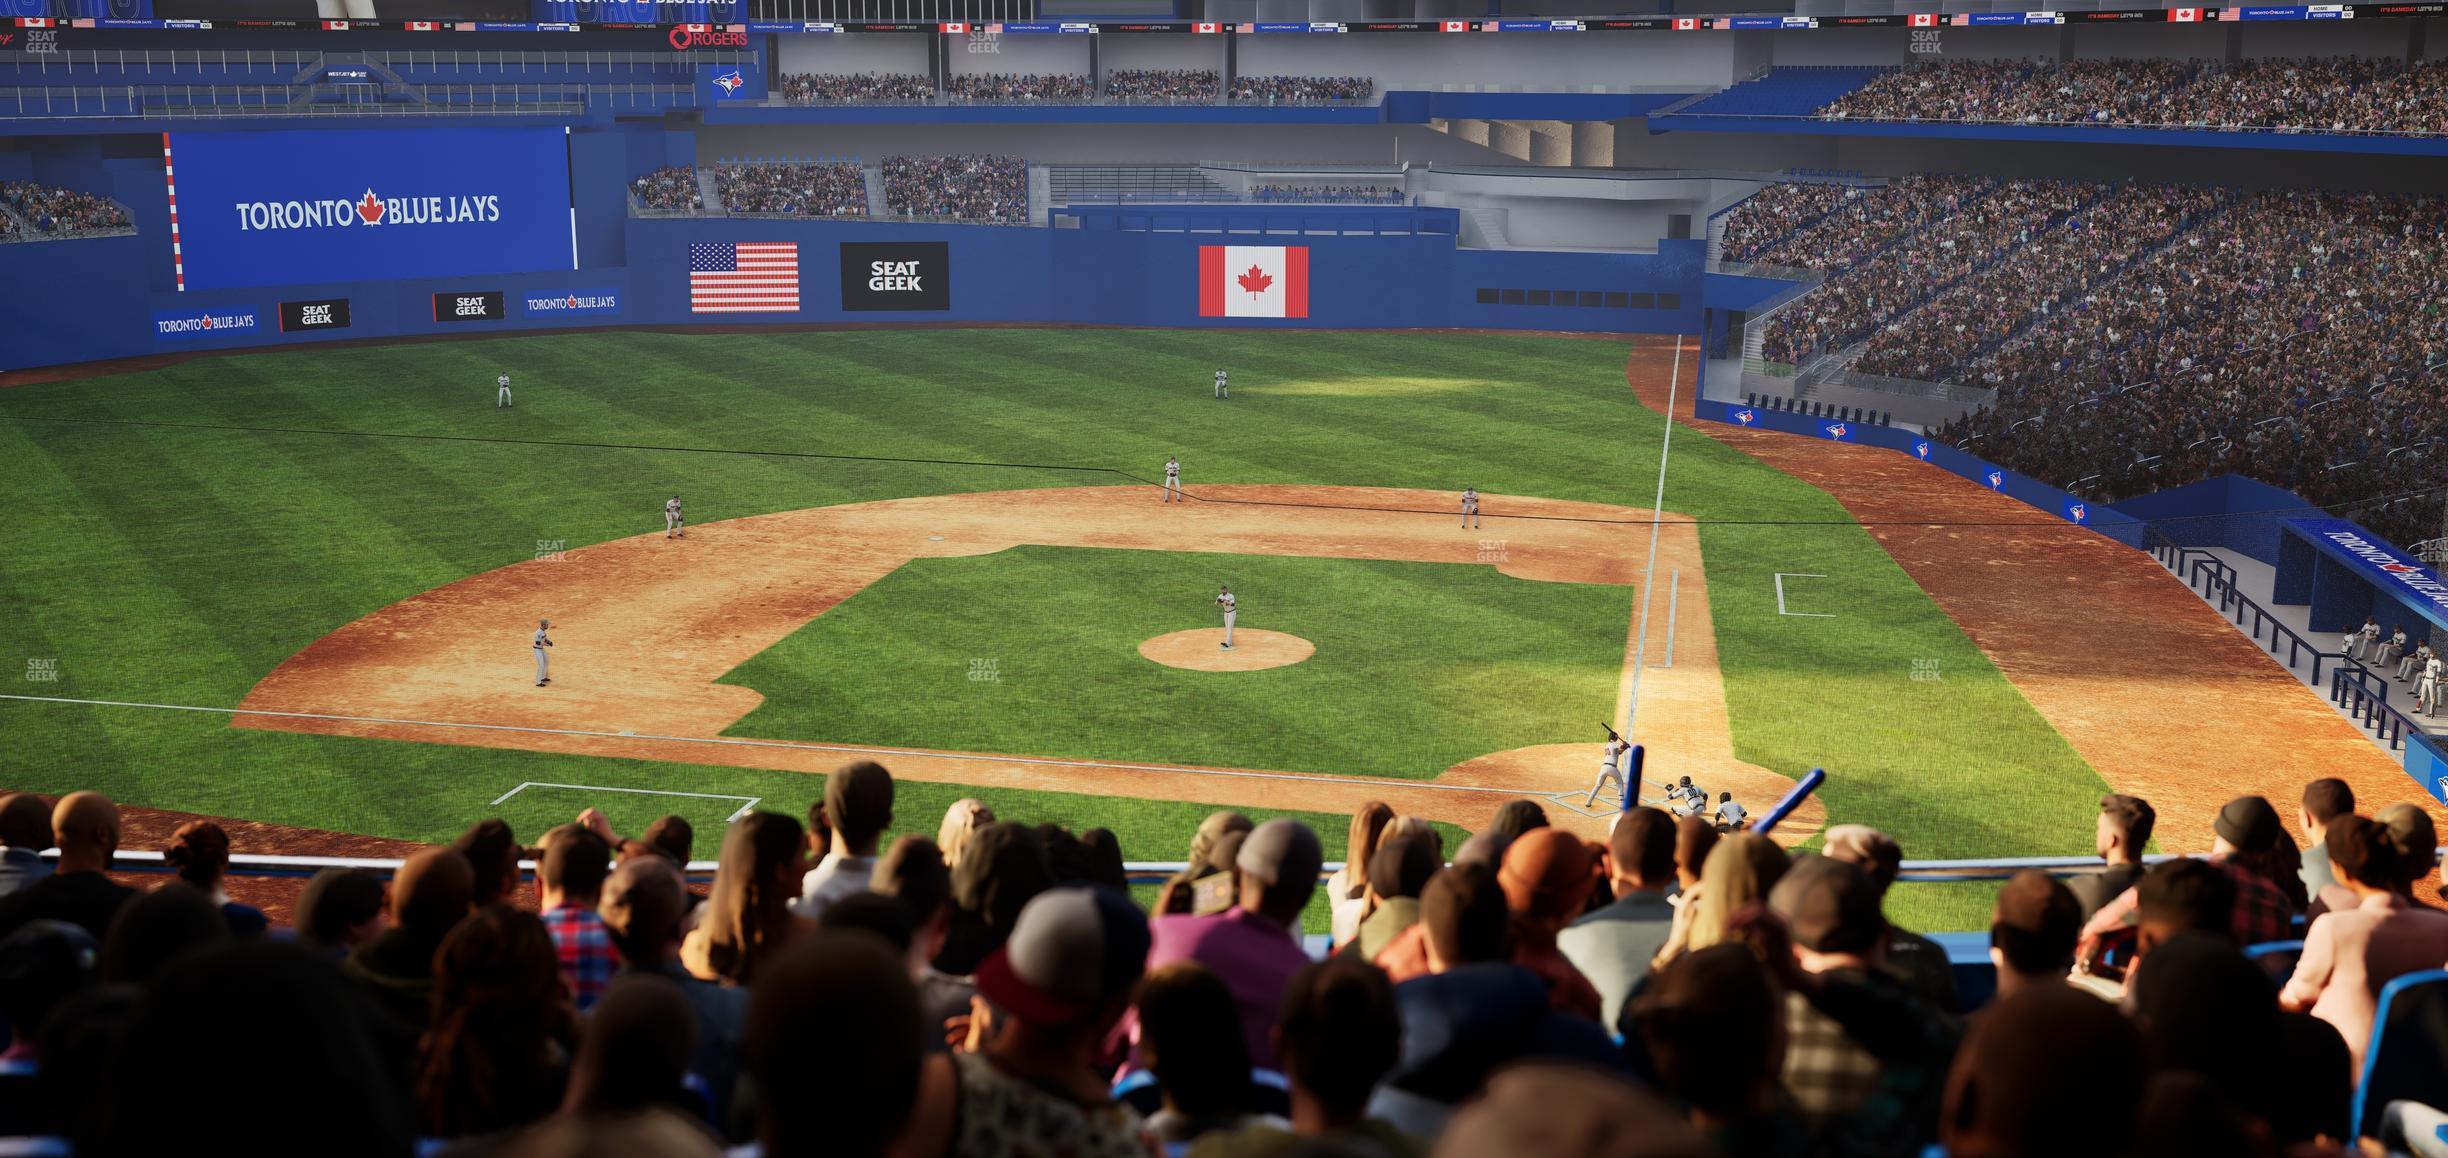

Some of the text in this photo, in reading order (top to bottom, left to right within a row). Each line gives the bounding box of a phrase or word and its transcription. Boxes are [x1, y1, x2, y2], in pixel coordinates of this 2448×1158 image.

[693, 32, 748, 46] ROGERS
[236, 195, 500, 231] TORONTO BLUE JAYS
[871, 260, 920, 276] SEAT
[869, 276, 923, 292] GEEK
[456, 296, 485, 307] SEAT
[528, 296, 615, 311] TORONTO BLUE JAYS
[302, 304, 331, 315] SEAT
[455, 305, 487, 316] GEEK
[158, 314, 254, 333] TORONTO BLUE JAYS
[301, 313, 333, 325] GEEK
[2323, 531, 2400, 564] TORONTO
